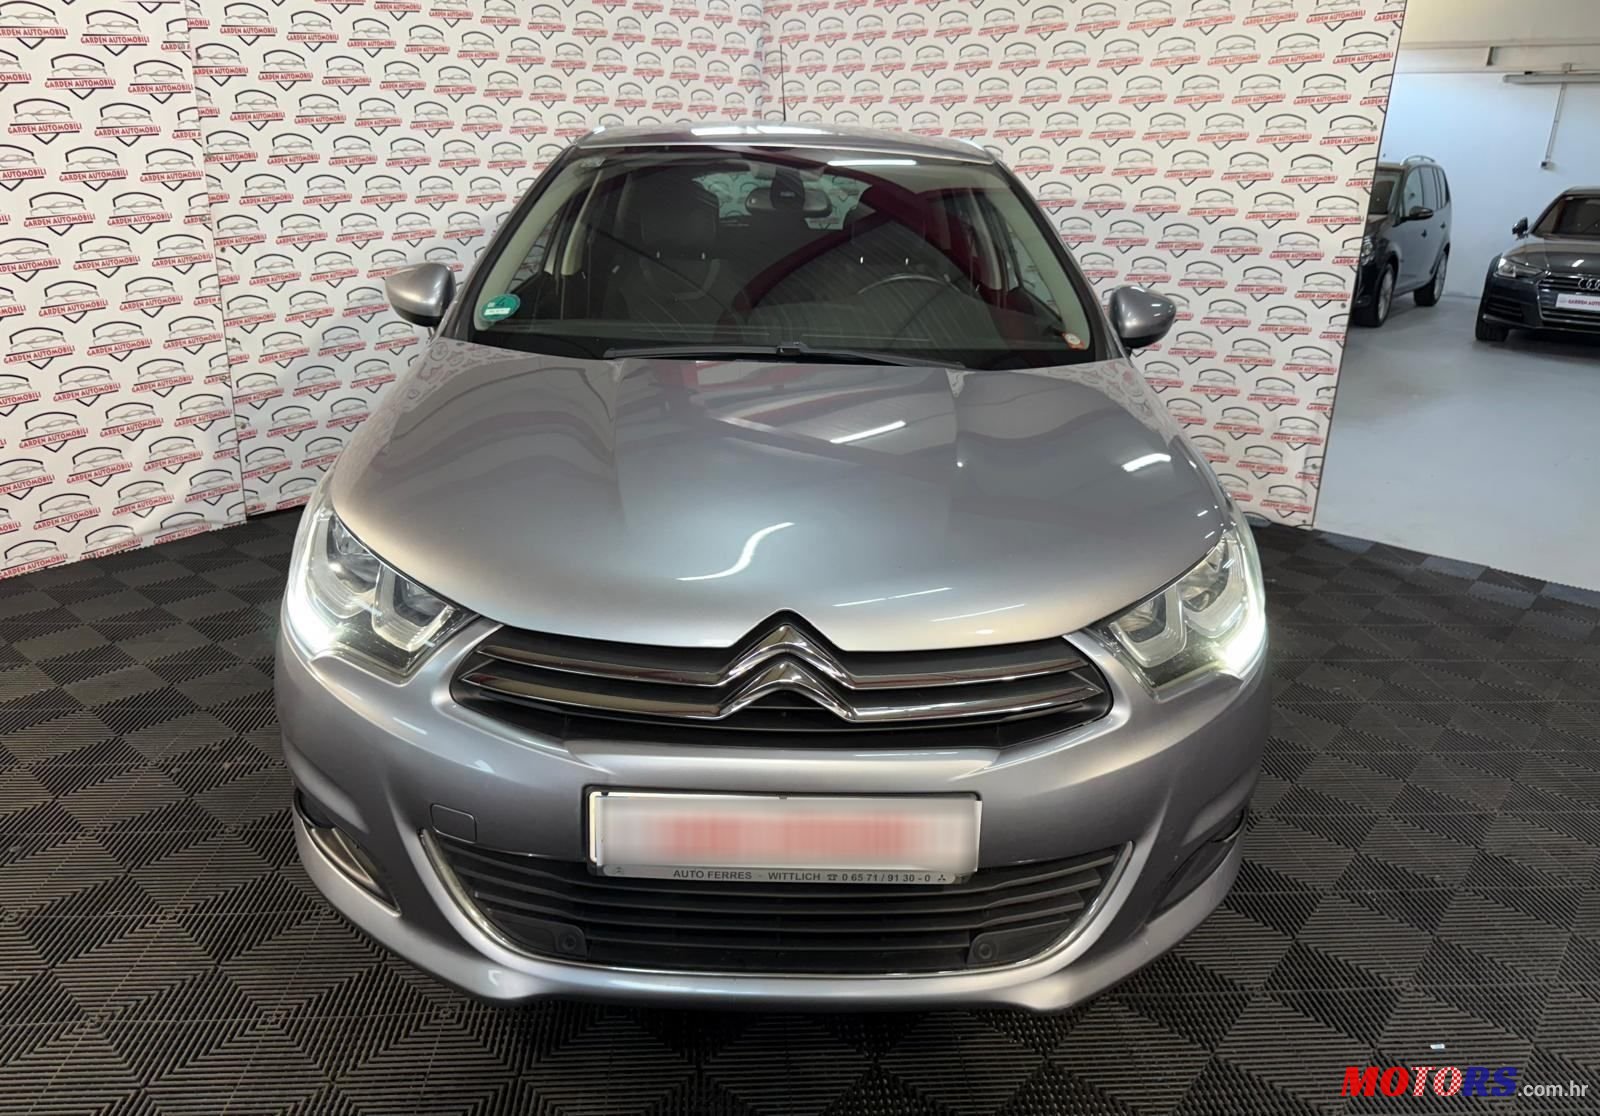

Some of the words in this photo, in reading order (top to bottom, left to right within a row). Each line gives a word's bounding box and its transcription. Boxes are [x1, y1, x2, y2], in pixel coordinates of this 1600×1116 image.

[23, 28, 69, 36] AUTOMOBILI
[80, 36, 107, 44] GARDEN
[44, 79, 73, 88] GARDEN
[75, 77, 117, 87] AUTOMOBILI
[127, 84, 153, 93] GARDEN
[155, 82, 193, 92] AUTOMOBILI
[7, 124, 36, 134] GARDEN
[38, 121, 81, 132] AUTOMOBILI
[94, 127, 120, 137] GARDEN
[121, 124, 161, 135] AUTOMOBILI
[2, 168, 47, 179] AUTOMOBILI
[59, 172, 87, 182] GARDEN
[88, 168, 129, 179] AUTOMOBILI
[139, 172, 165, 182] GARDEN
[166, 169, 206, 180] AUTOMOBILI
[23, 216, 51, 228] GARDEN
[53, 211, 96, 224] AUTOMOBILI
[106, 215, 132, 226] GARDEN
[133, 210, 171, 223] AUTOMOBILI
[18, 258, 61, 271] AUTOMOBILI
[72, 259, 100, 272] GARDEN
[101, 254, 140, 268] AUTOMOBILI
[151, 256, 176, 269] GARDEN
[177, 250, 214, 266] AUTOMOBILI
[38, 304, 65, 317] GARDEN
[67, 297, 109, 312] AUTOMOBILI
[119, 299, 144, 313] GARDEN
[145, 293, 184, 309] AUTOMOBILI
[86, 344, 112, 357] GARDEN
[114, 336, 153, 352] AUTOMOBILI
[162, 338, 186, 352] GARDEN
[188, 330, 224, 347] AUTOMOBILI
[3, 351, 31, 365] GARDEN
[33, 342, 76, 359] AUTOMOBILI
[53, 389, 79, 403] GARDEN
[81, 380, 121, 397] AUTOMOBILI
[131, 380, 156, 395] GARDEN
[157, 373, 193, 390] AUTOMOBILI
[99, 424, 125, 440] GARDEN
[126, 414, 164, 434] AUTOMOBILI
[173, 415, 197, 430] GARDEN
[198, 407, 231, 424] AUTOMOBILI
[18, 435, 46, 452] GARDEN
[48, 425, 89, 444] AUTOMOBILI
[142, 457, 166, 474] GARDEN
[168, 448, 204, 467] AUTOMOBILI
[66, 469, 92, 486] GARDEN
[93, 459, 133, 479] AUTOMOBILI
[13, 474, 56, 491] AUTOMOBILI
[111, 501, 136, 518] GARDEN
[137, 492, 175, 511] AUTOMOBILI
[32, 516, 59, 531] GARDEN
[61, 504, 101, 524] AUTOMOBILI
[27, 551, 68, 571] AUTOMOBILI
[673, 869, 704, 879] AUTO
[707, 870, 753, 880] FERRES
[767, 872, 821, 881] WITTLICH
